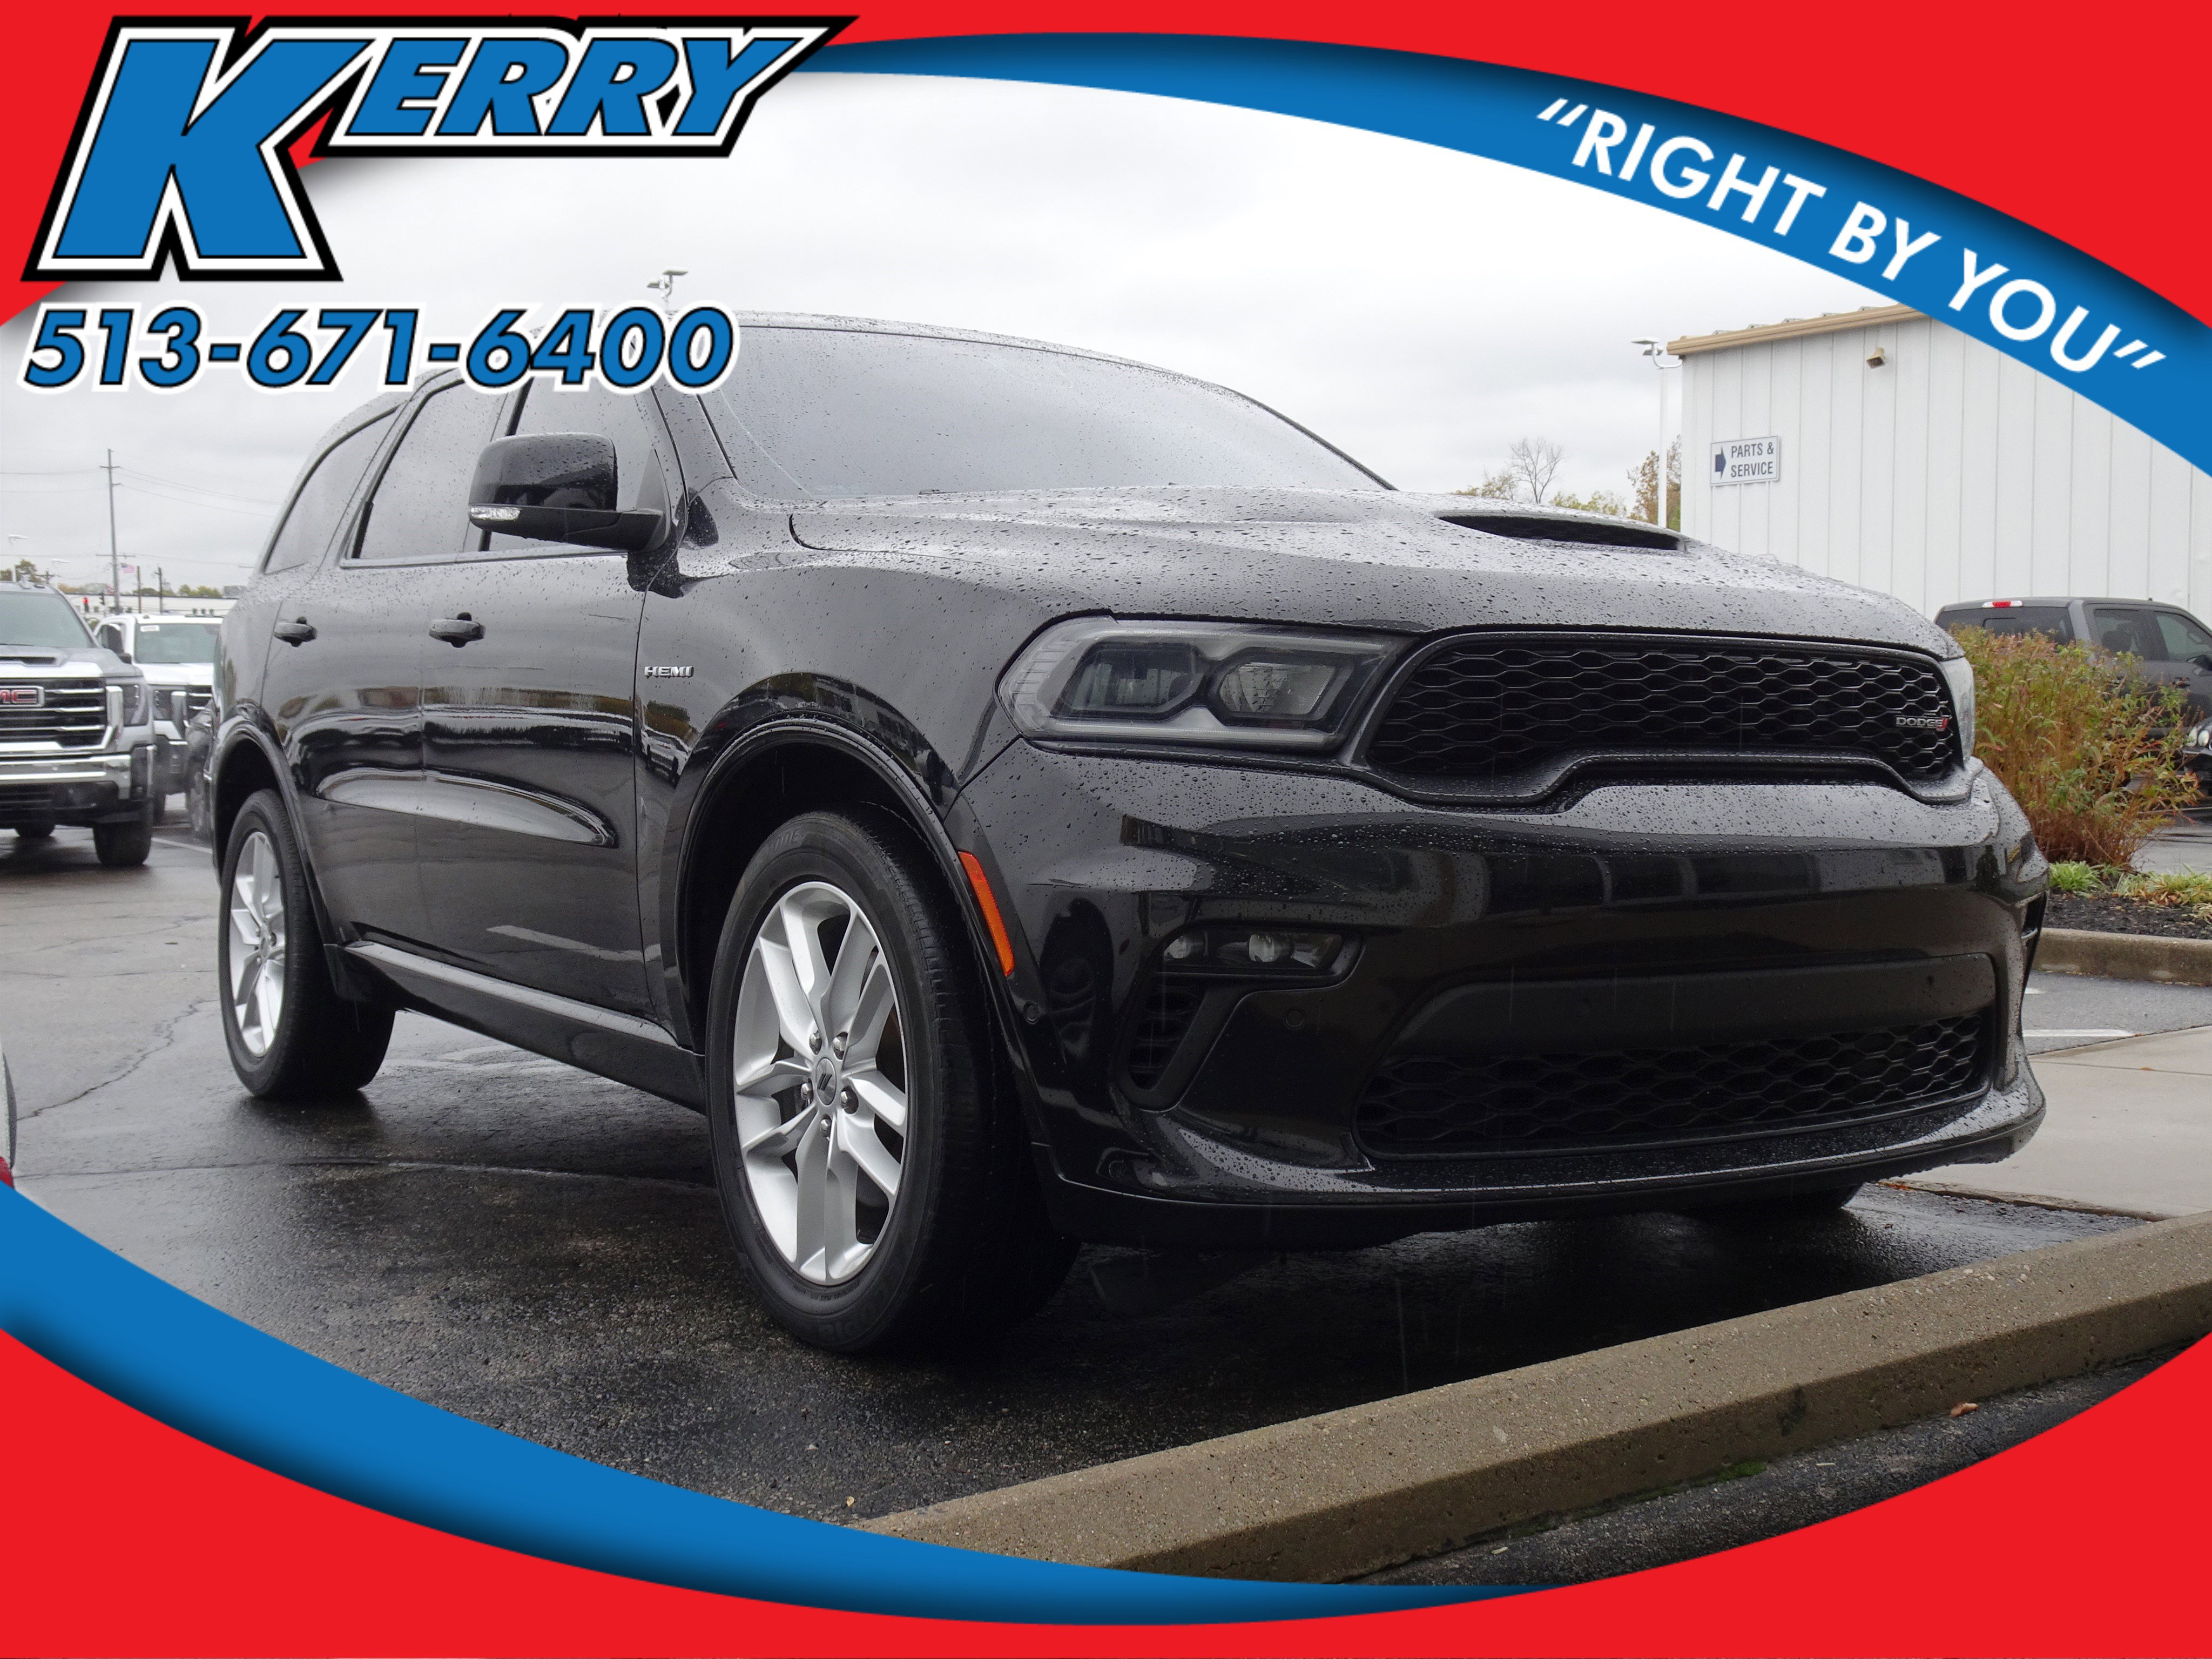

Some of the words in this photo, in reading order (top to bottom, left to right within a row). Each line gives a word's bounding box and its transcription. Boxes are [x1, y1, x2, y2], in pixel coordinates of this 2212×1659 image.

[1731, 443, 1763, 458] PARTS
[1767, 442, 1774, 454] &
[1731, 461, 1773, 477] SERVICE
[644, 666, 694, 677] HEMI
[1896, 717, 1943, 727] DODGE
